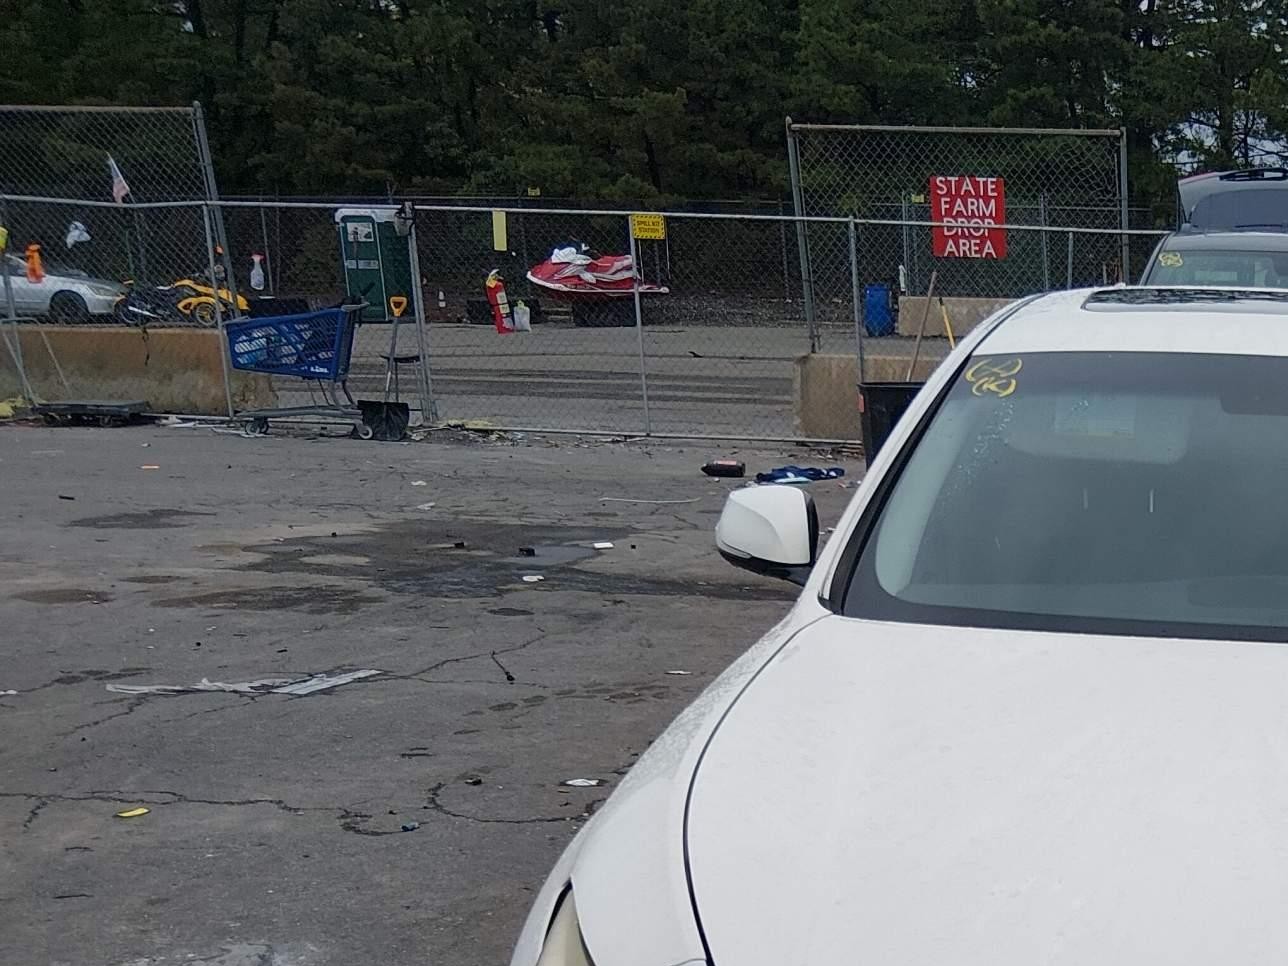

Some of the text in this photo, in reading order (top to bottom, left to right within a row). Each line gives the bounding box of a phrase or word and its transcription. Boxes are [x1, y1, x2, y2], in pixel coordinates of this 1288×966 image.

[936, 176, 998, 196] STATE
[940, 197, 996, 217] FARM
[943, 217, 996, 237] DROP
[943, 238, 997, 258] AREA
